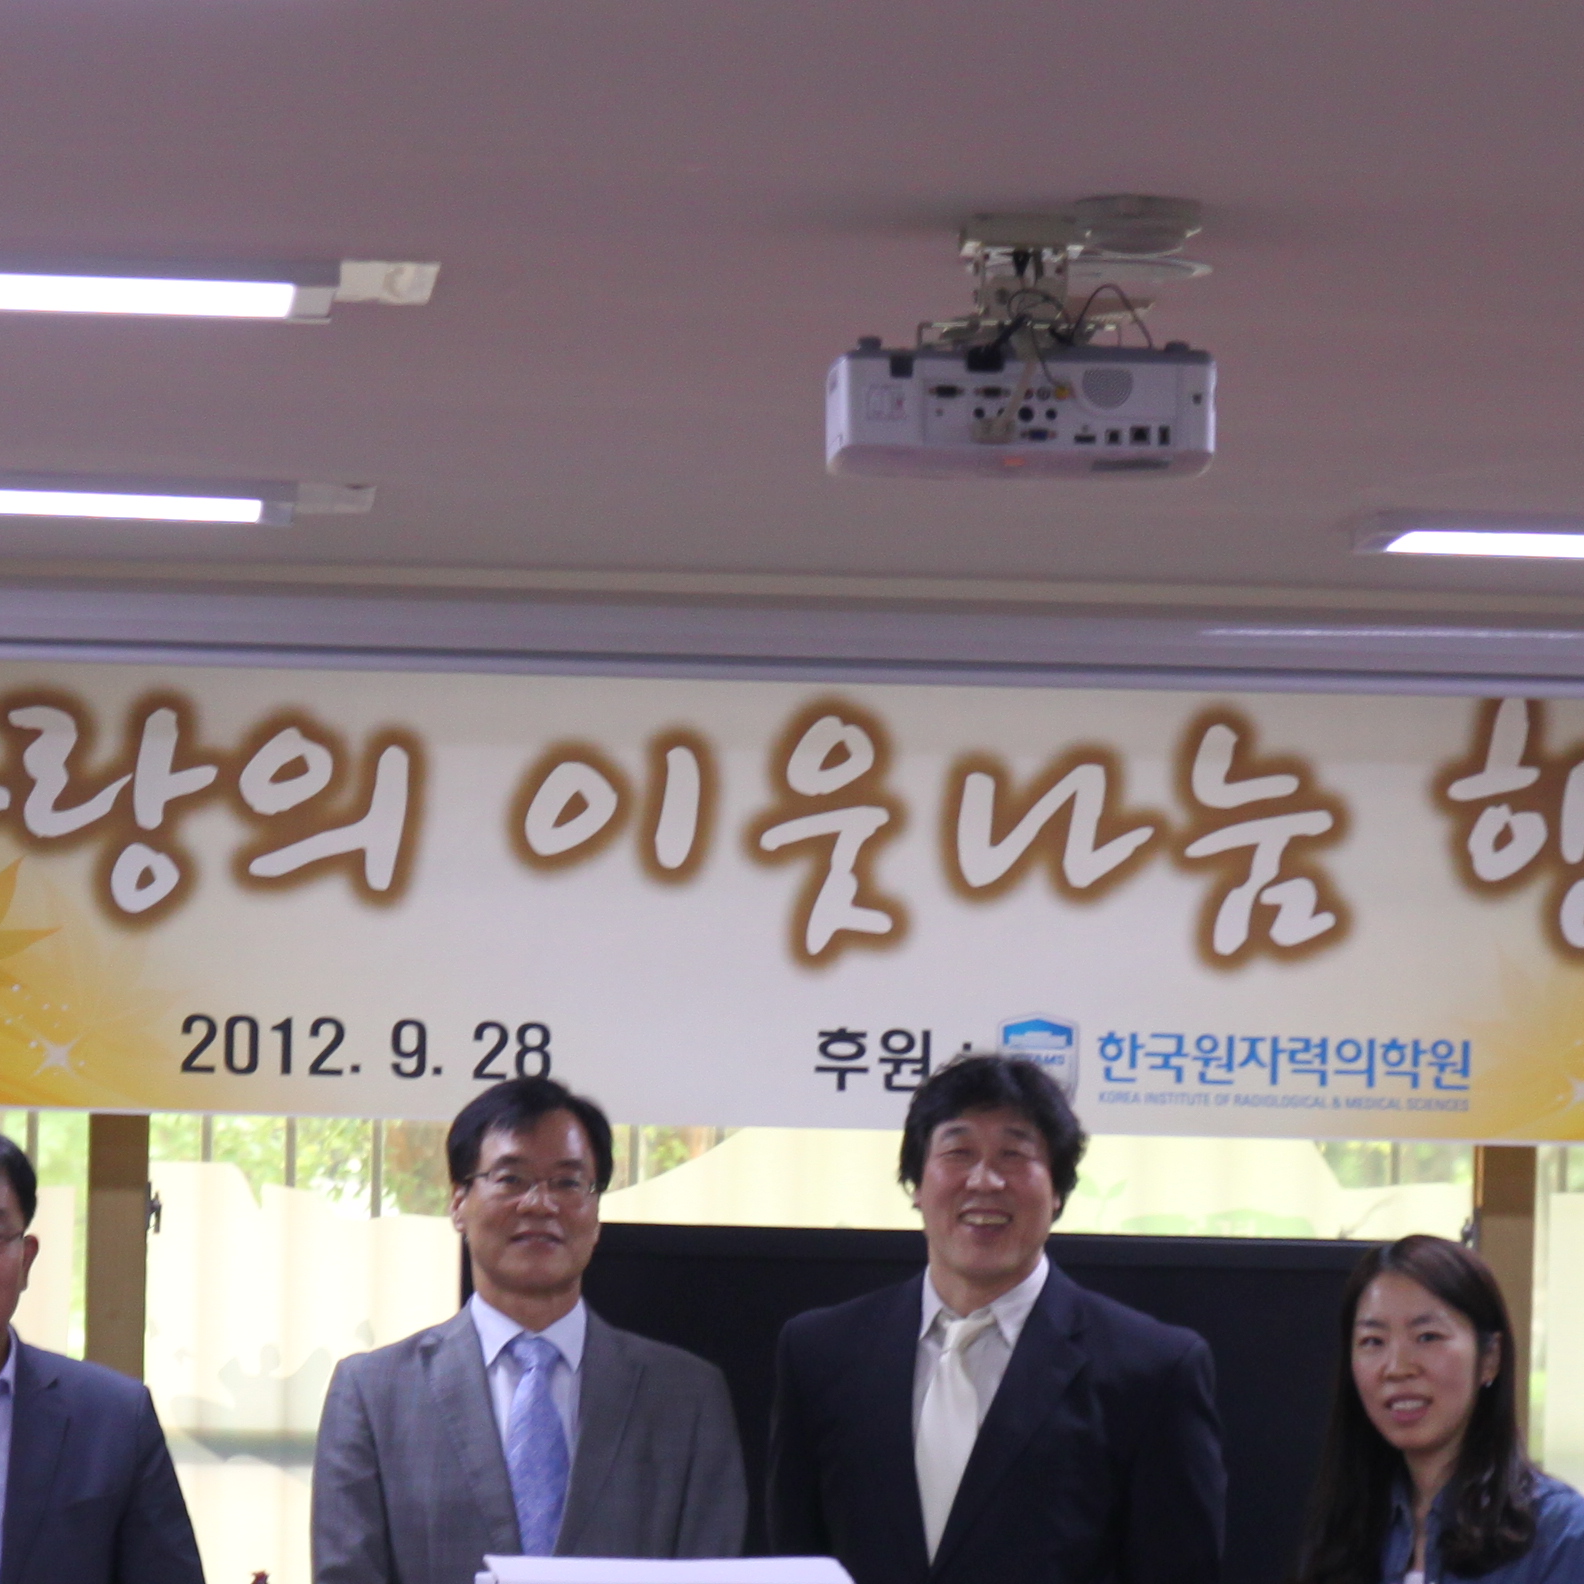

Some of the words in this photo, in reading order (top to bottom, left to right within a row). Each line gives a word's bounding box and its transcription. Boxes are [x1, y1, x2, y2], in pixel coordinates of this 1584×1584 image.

[179, 1012, 362, 1078] 2012.
[390, 1017, 443, 1081] 9.
[471, 1019, 553, 1082] 28
[813, 1026, 932, 1094] 후원
[1097, 1030, 1471, 1091] 한국원자력의학원
[1097, 1091, 1142, 1105] KOREA
[1144, 1092, 1211, 1107] INSTITUTE
[1214, 1093, 1230, 1107] OF
[1233, 1094, 1328, 1110] RADIOLOGICAL
[1345, 1096, 1402, 1111] MEDICAL
[1405, 1097, 1471, 1113] SCIENCES
